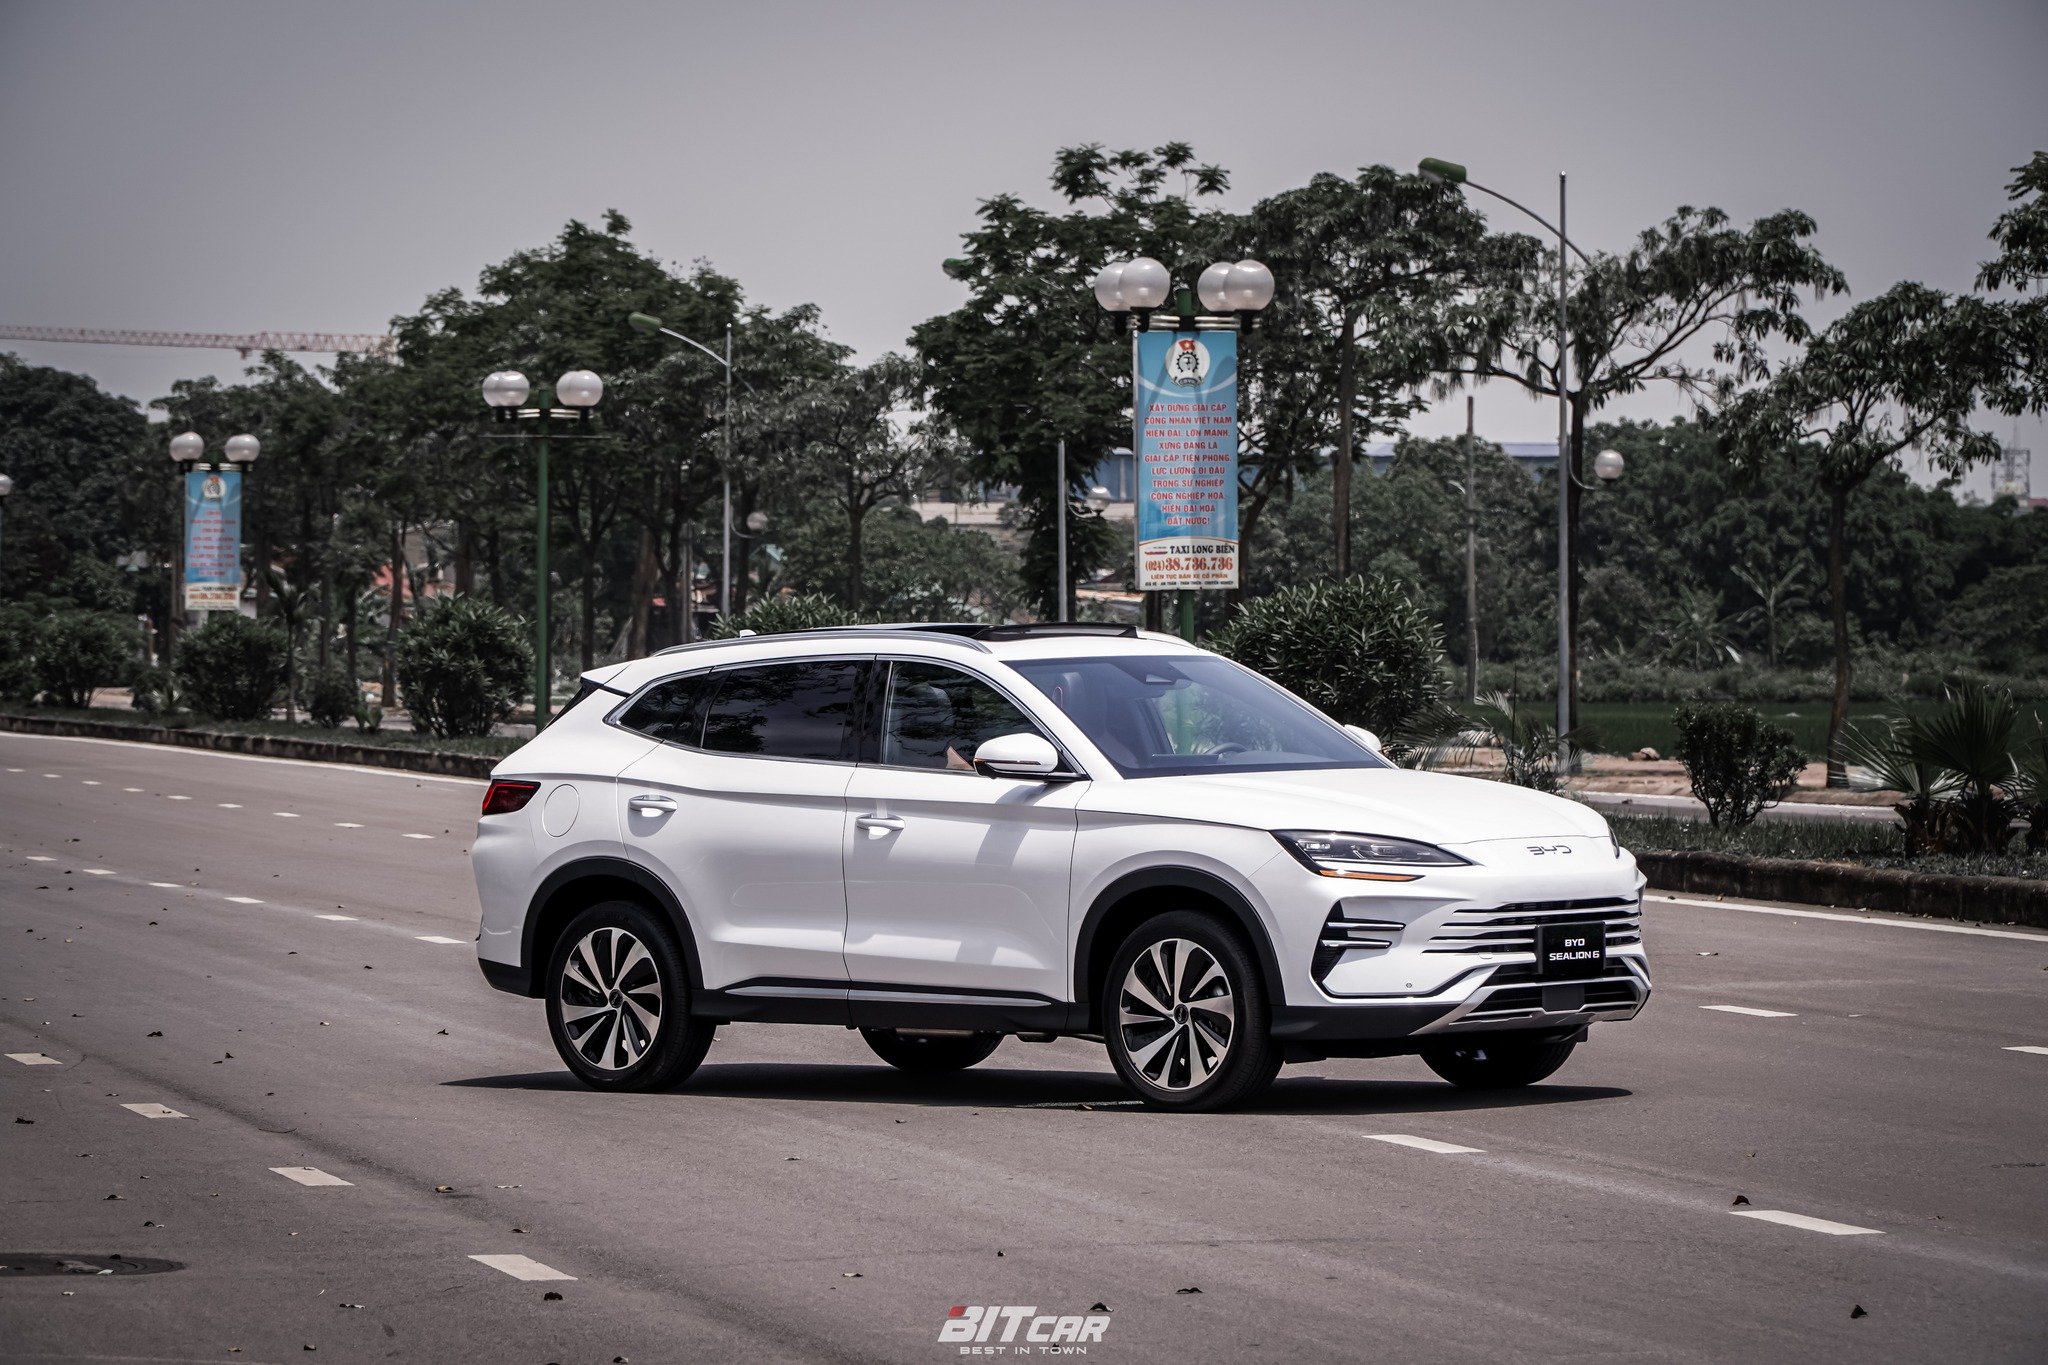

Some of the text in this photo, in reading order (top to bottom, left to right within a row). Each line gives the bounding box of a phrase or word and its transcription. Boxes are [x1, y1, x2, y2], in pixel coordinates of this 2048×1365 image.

[1192, 403, 1209, 412] GIAI
[1213, 416, 1232, 425] NAM
[1144, 453, 1161, 462] GIAI
[1152, 479, 1179, 488] TRONG
[1169, 545, 1190, 554] TAXI
[1191, 545, 1214, 554] LONG
[1526, 844, 1572, 856] BYD
[1564, 938, 1586, 947] BYD
[1548, 950, 1600, 961] SEALION 6
